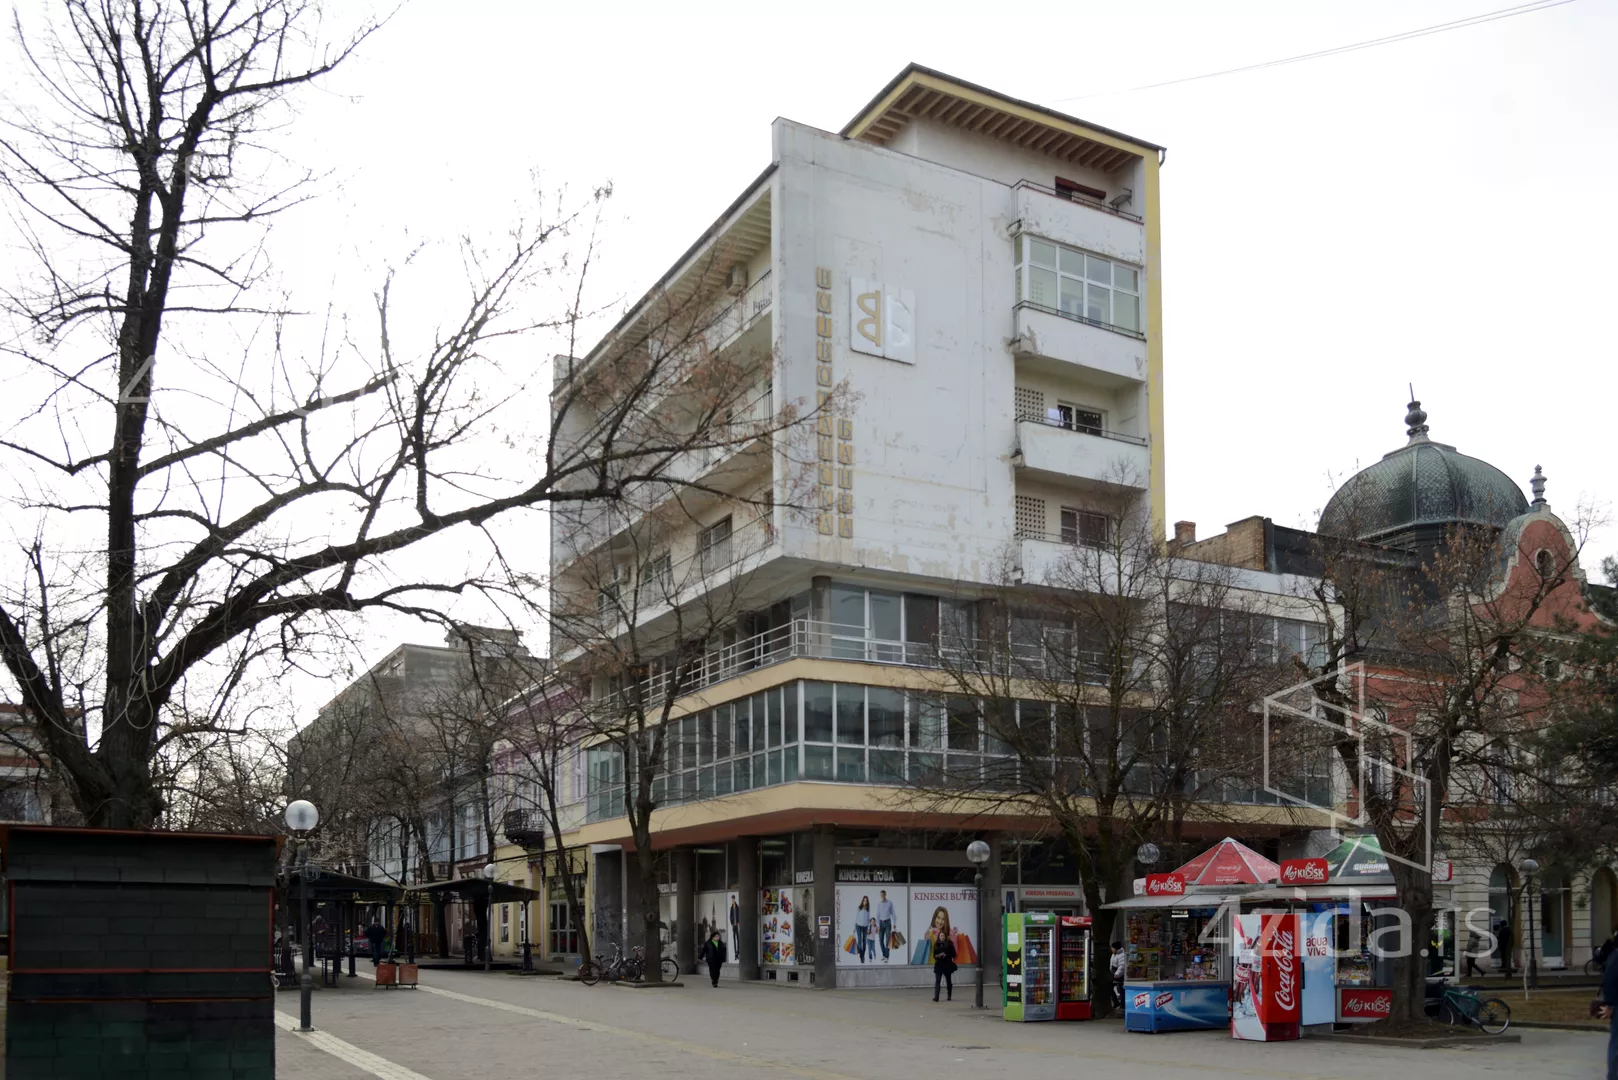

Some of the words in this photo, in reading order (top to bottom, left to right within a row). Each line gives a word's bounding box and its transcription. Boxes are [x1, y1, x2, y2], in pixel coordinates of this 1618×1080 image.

[838, 869, 870, 881] KINESKA
[873, 870, 894, 882] ROBA
[1297, 865, 1324, 879] KIOSK
[914, 892, 948, 901] KINESKI
[1307, 947, 1327, 957] viva
[1344, 998, 1364, 1013] Moj
[1364, 998, 1391, 1011] KIOS
